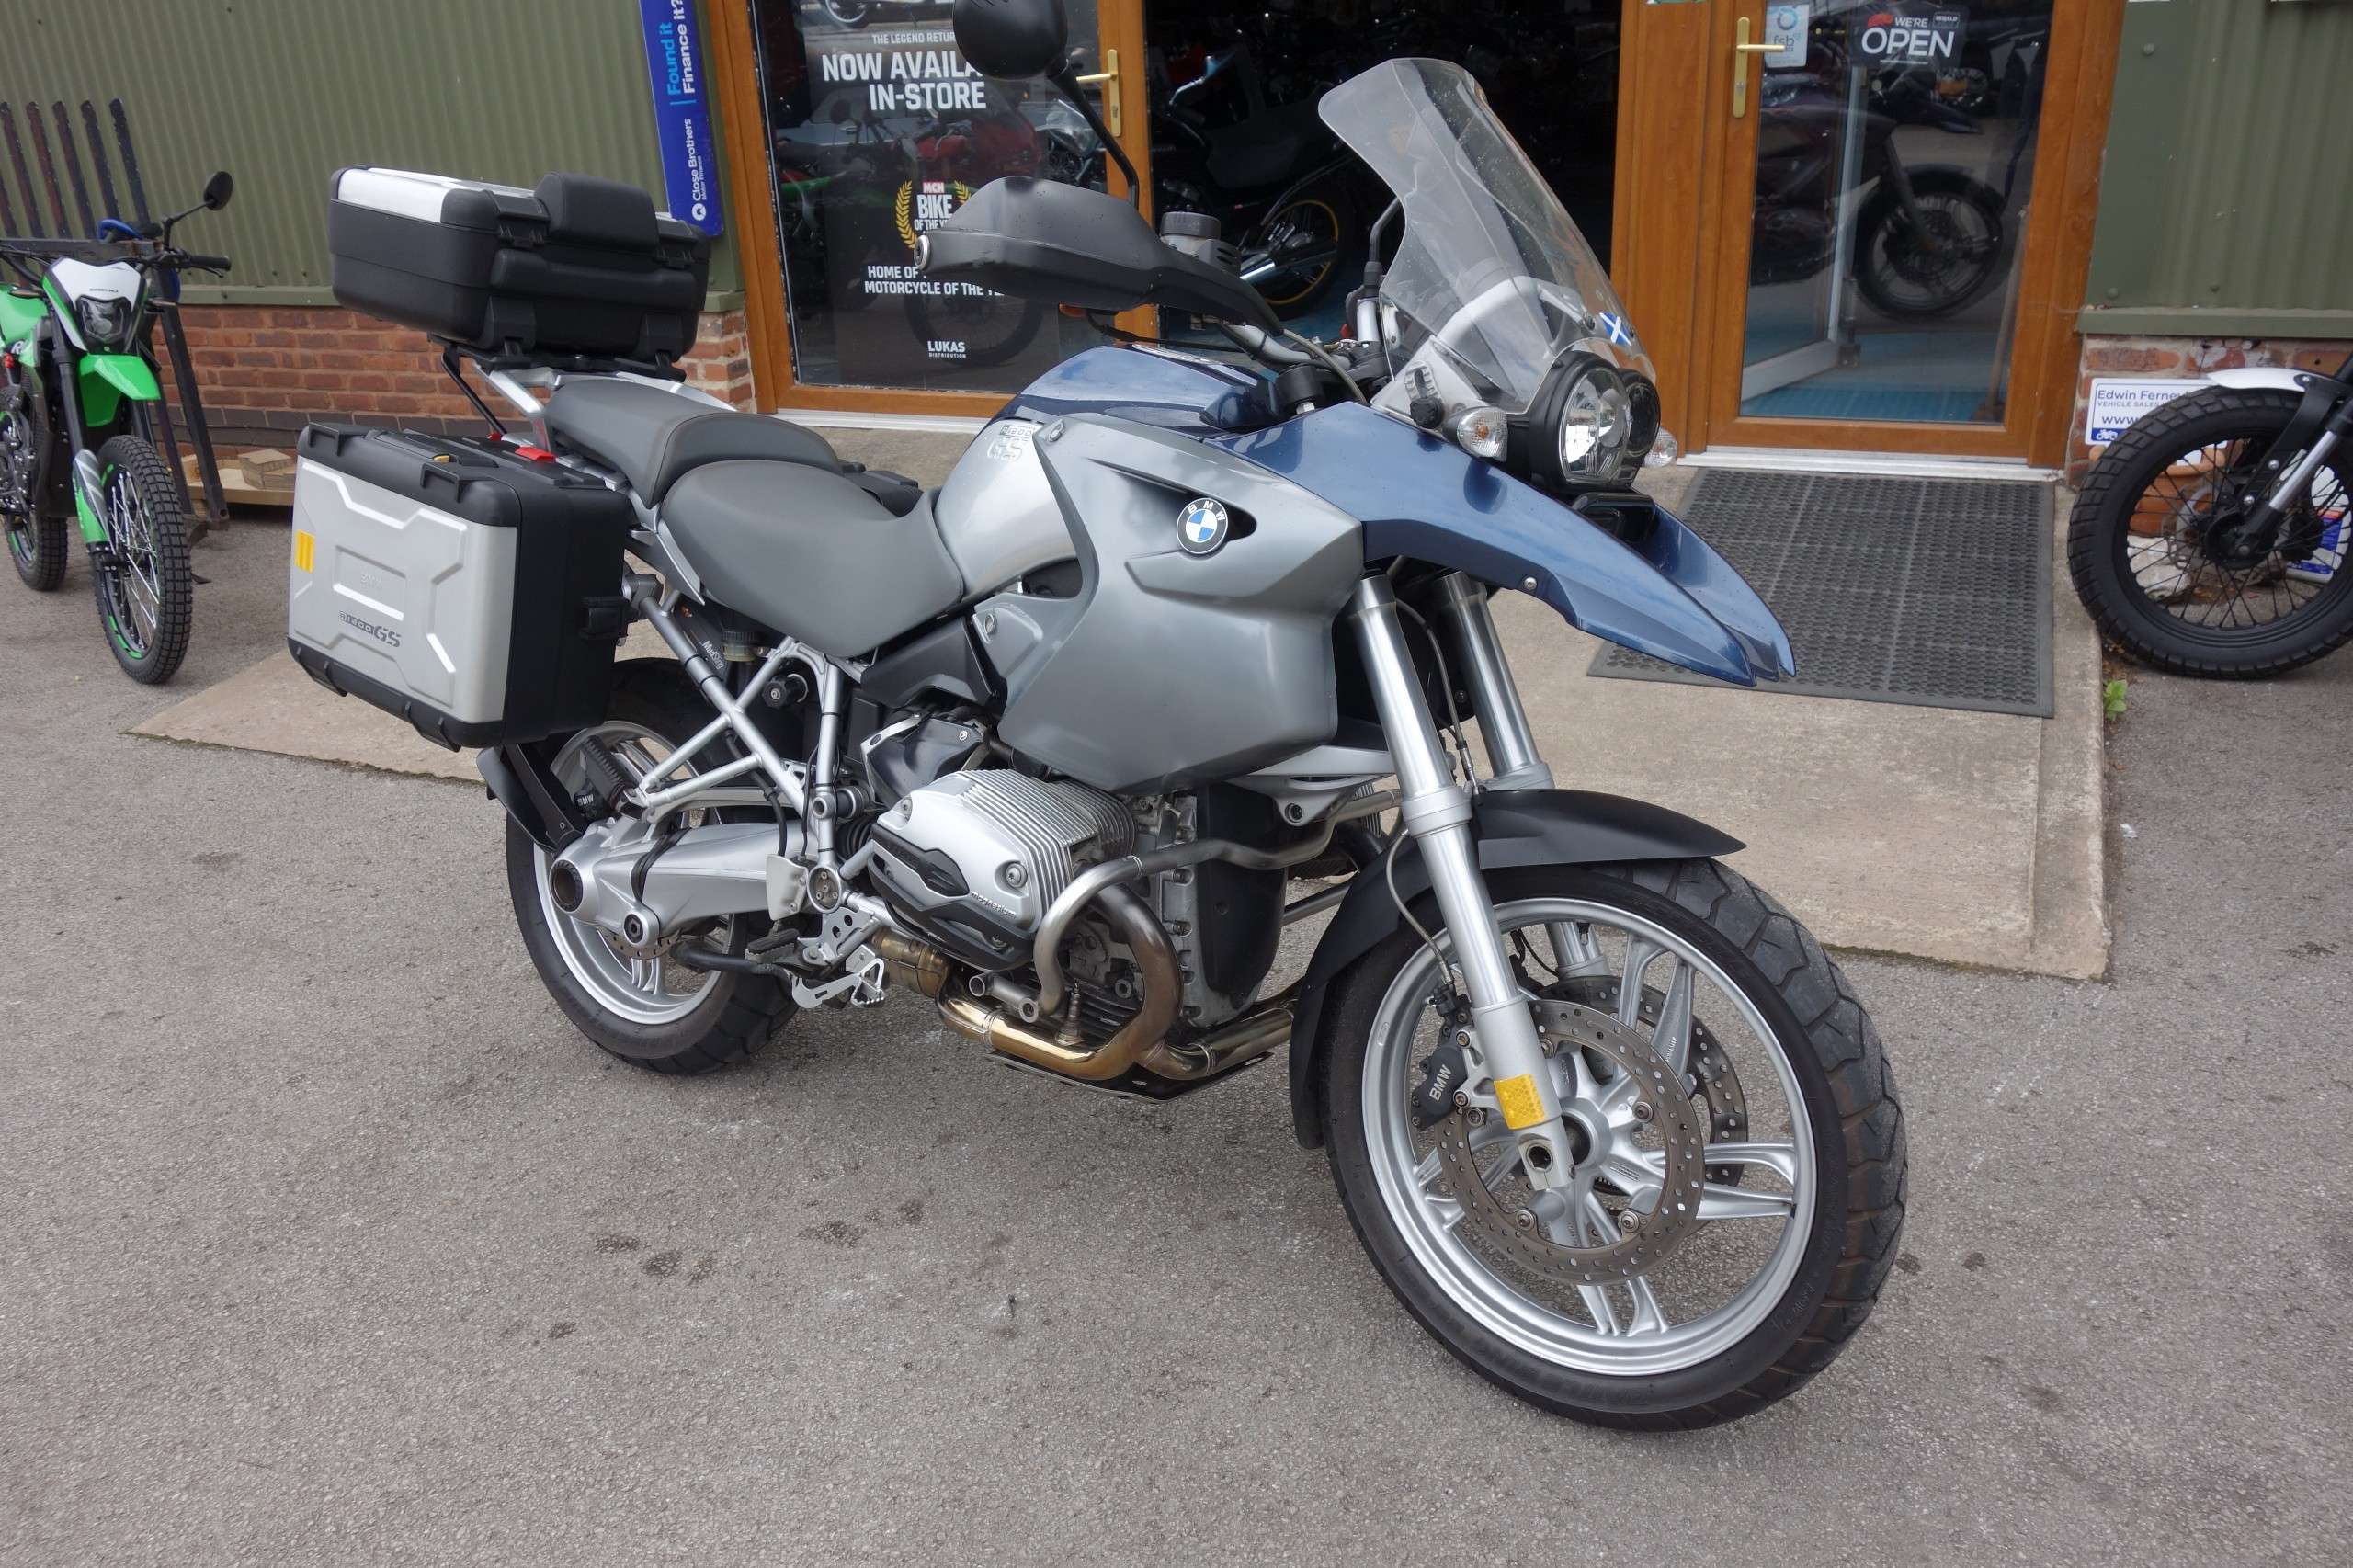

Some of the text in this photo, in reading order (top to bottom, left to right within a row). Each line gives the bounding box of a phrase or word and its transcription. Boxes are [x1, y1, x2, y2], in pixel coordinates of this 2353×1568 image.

[1894, 17, 1929, 28] WE'RE
[671, 0, 696, 94] Finance it?
[872, 31, 957, 44] THE LEGEND RETUR
[1861, 27, 1955, 58] OPEN
[659, 22, 682, 96] Found it
[822, 50, 984, 81] NOW AVAILA
[869, 81, 987, 111] IN-STORE
[684, 118, 701, 202] Close Brothers
[922, 181, 945, 194] MCN
[916, 194, 953, 219] BIKE
[914, 220, 925, 231] OF
[924, 219, 939, 231] THE
[867, 265, 919, 278] HOME OF
[864, 280, 941, 295] MOTORCYCLE
[944, 282, 959, 295] OF
[961, 283, 983, 296] THE
[926, 340, 966, 353] LUKAS
[2097, 389, 2136, 400] Edwin
[1187, 499, 1226, 521] BMW
[1429, 1063, 1452, 1102] BMW
